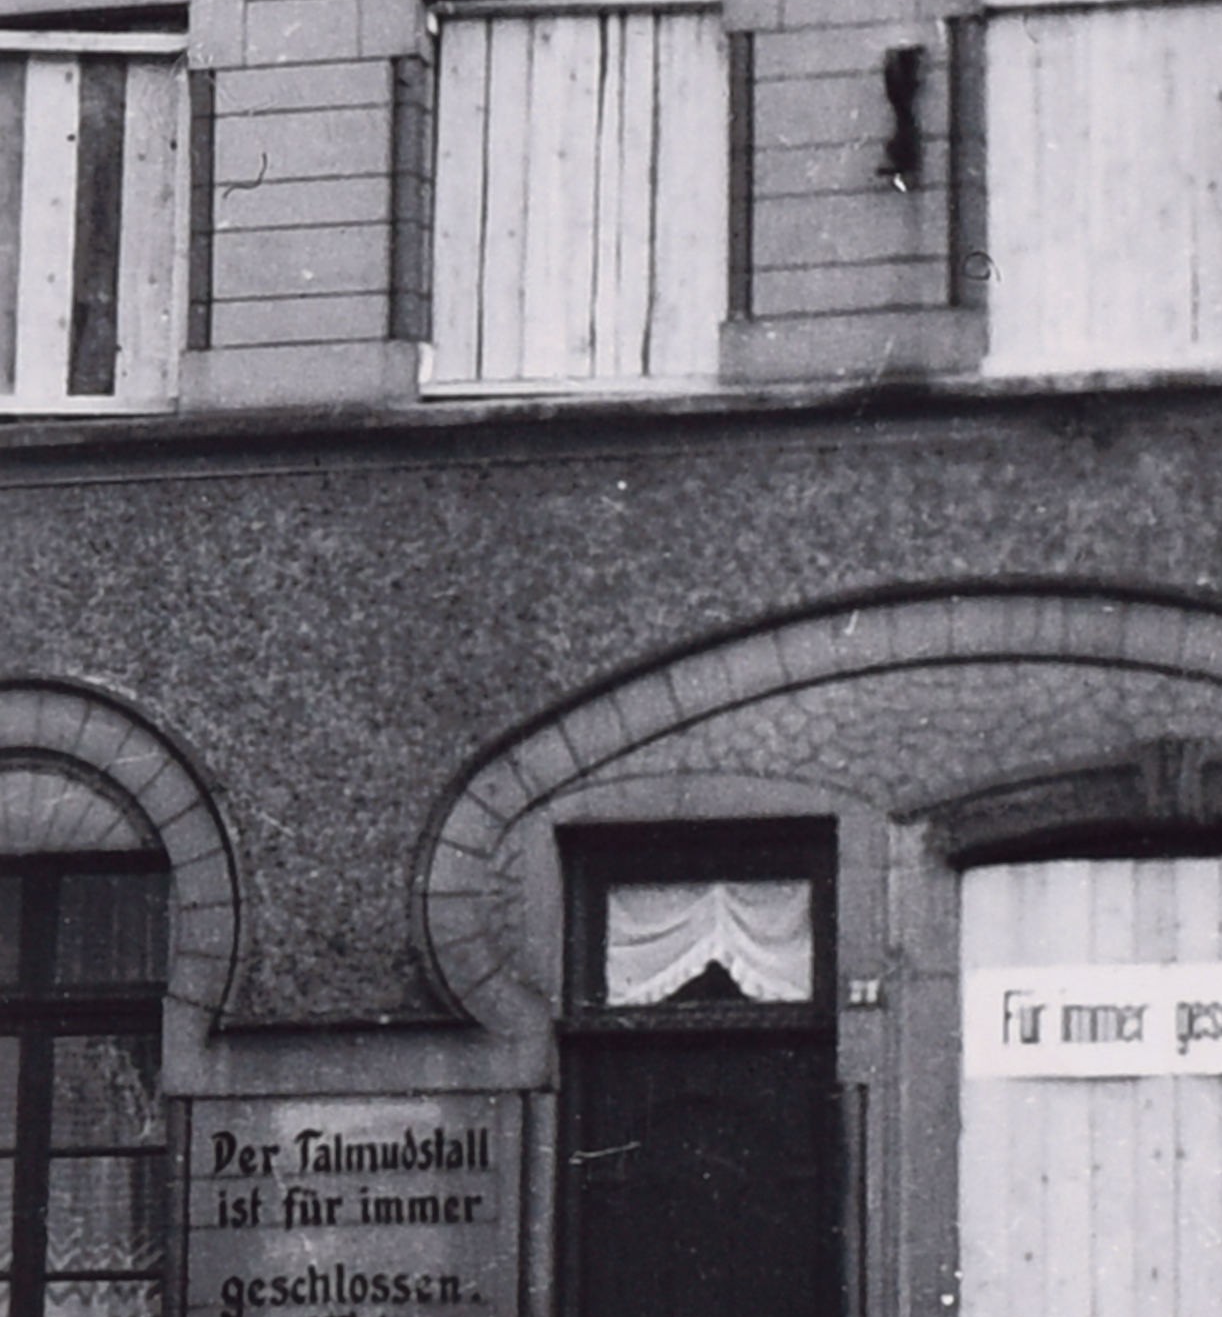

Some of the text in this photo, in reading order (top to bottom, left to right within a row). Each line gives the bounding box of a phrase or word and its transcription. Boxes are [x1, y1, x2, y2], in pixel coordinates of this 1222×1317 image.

[211, 1127, 489, 1175] Der Talmudstall
[218, 1186, 483, 1231] ist für immer
